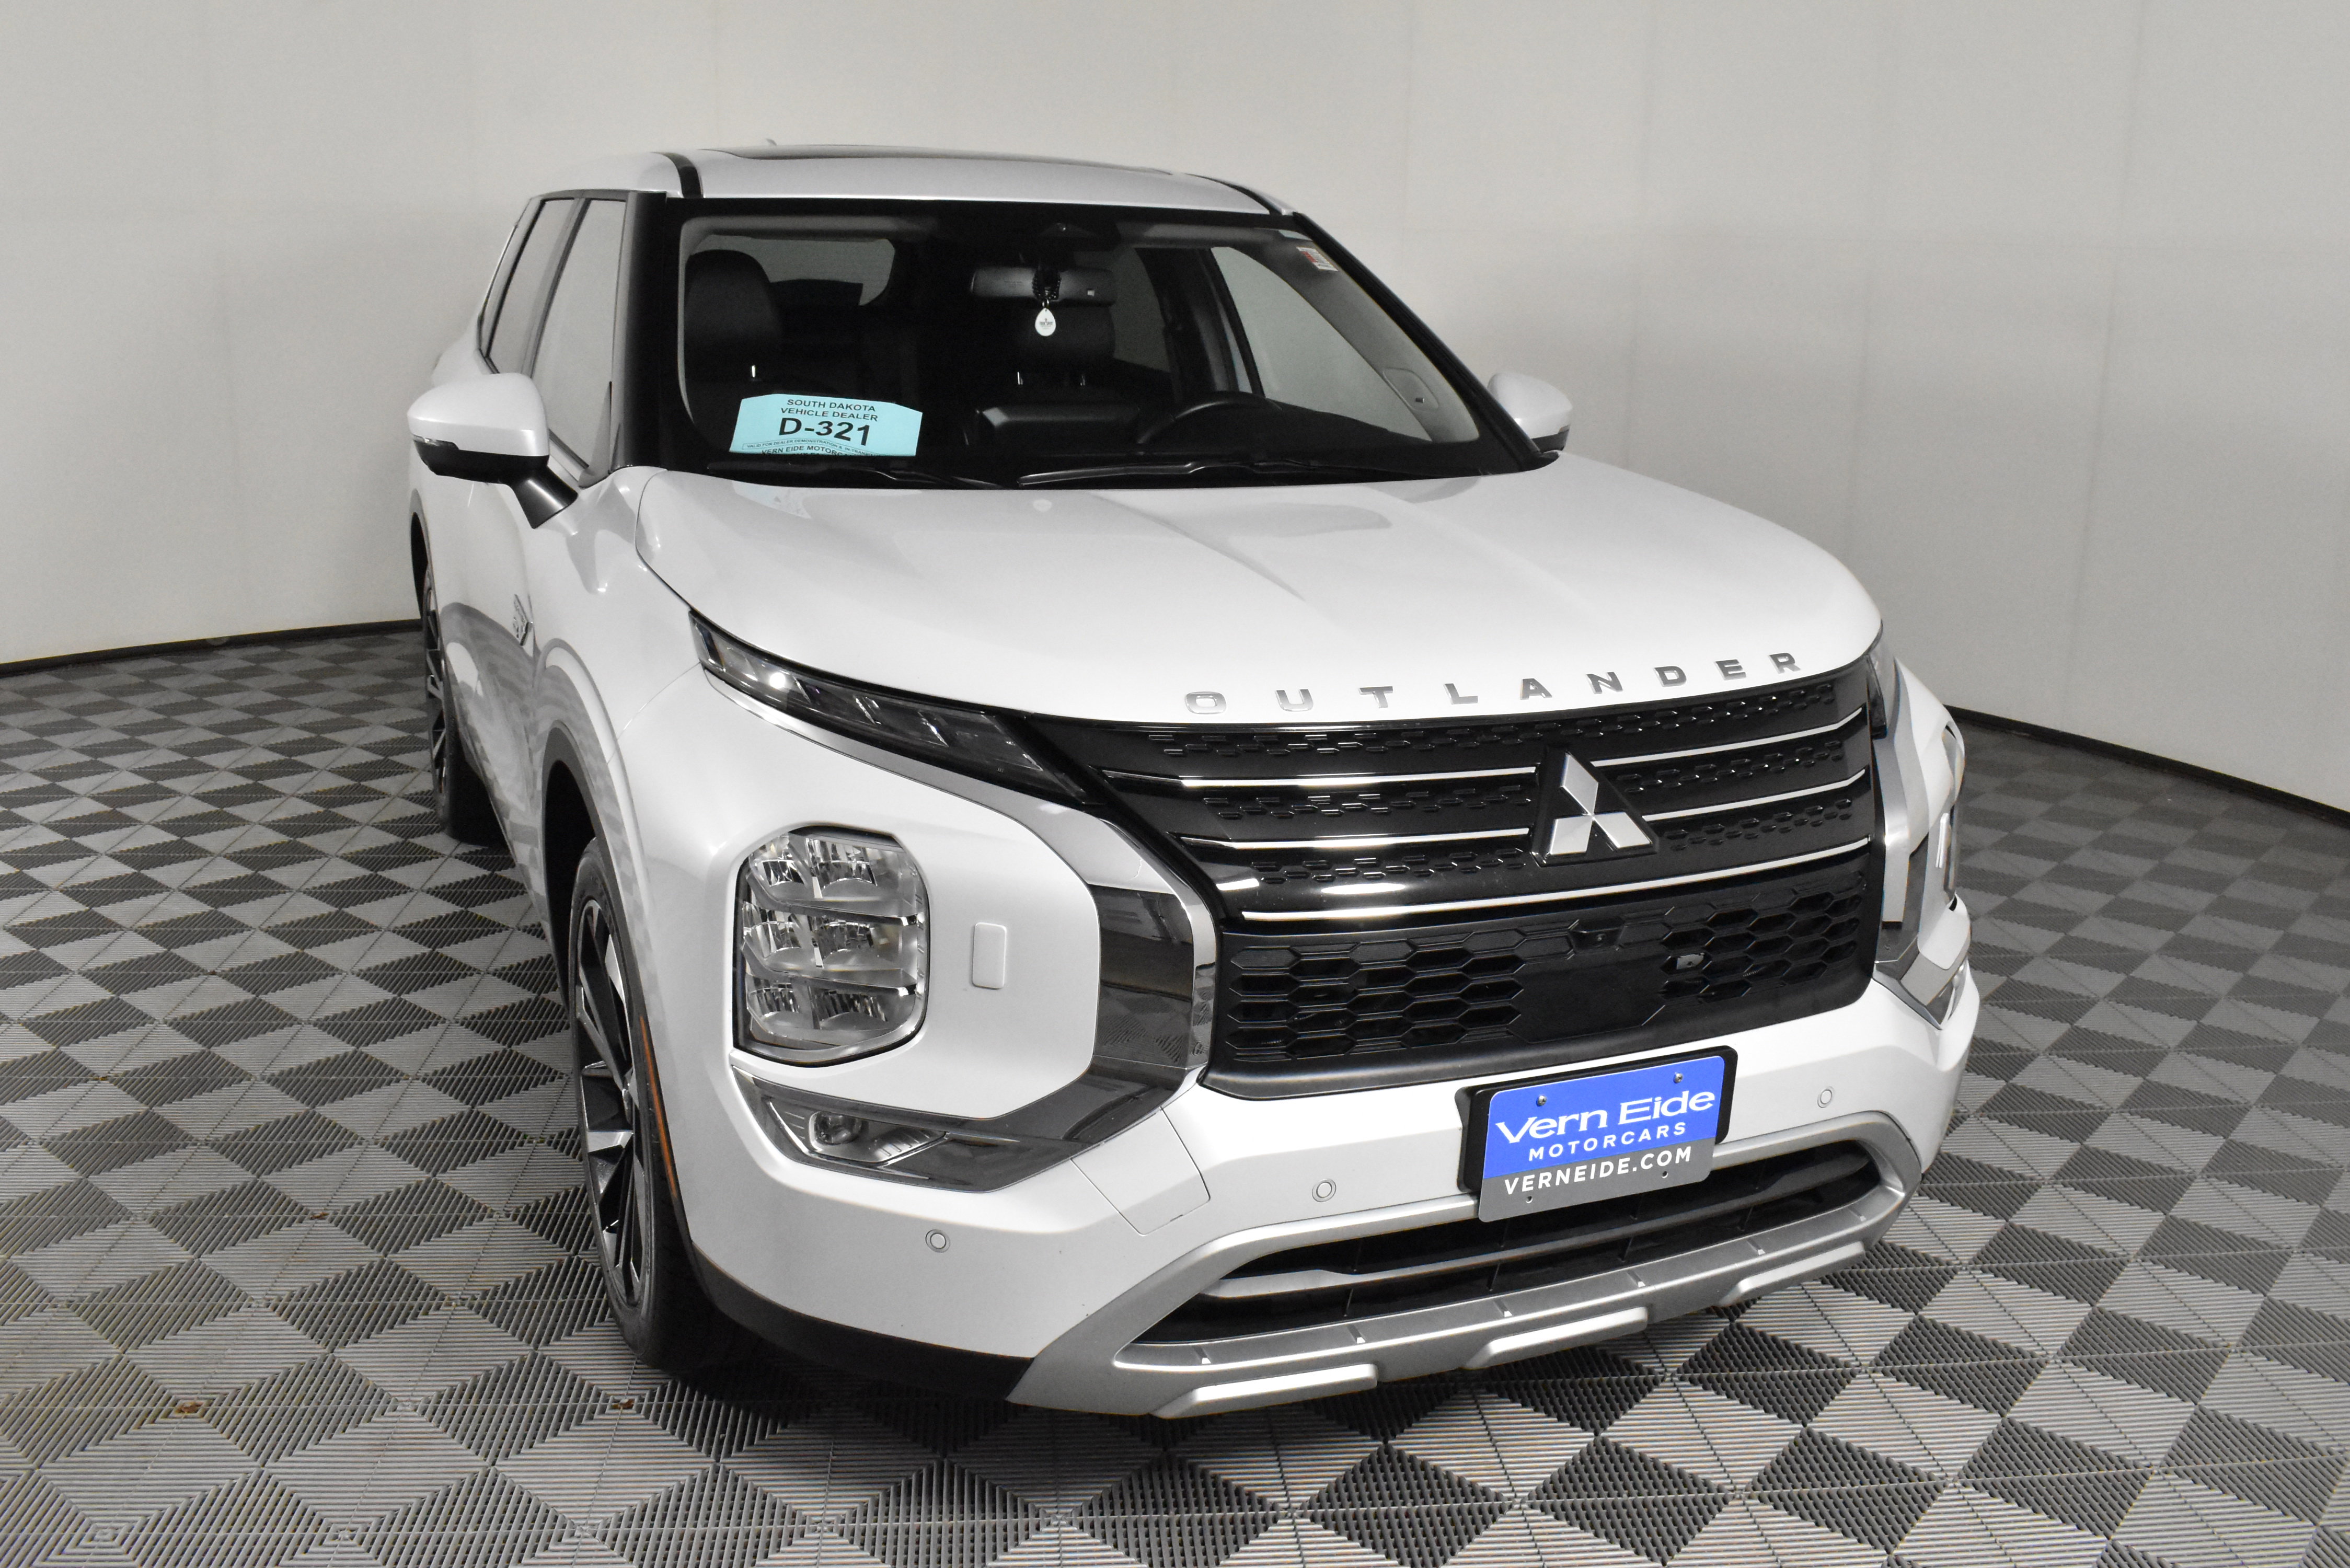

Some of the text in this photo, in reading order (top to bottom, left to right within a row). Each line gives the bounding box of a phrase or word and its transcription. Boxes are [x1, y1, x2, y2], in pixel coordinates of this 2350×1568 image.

[780, 408, 878, 421] VEHICLE DEALER
[787, 399, 876, 412] SOUTH DAKOTA
[779, 417, 870, 446] D-321
[1184, 651, 1802, 715] OUTLANDER
[1495, 1090, 1715, 1144] Vern Eide
[1528, 1122, 1686, 1161] MOTORCARS
[1504, 1146, 1692, 1195] VERNEIDE.COM
